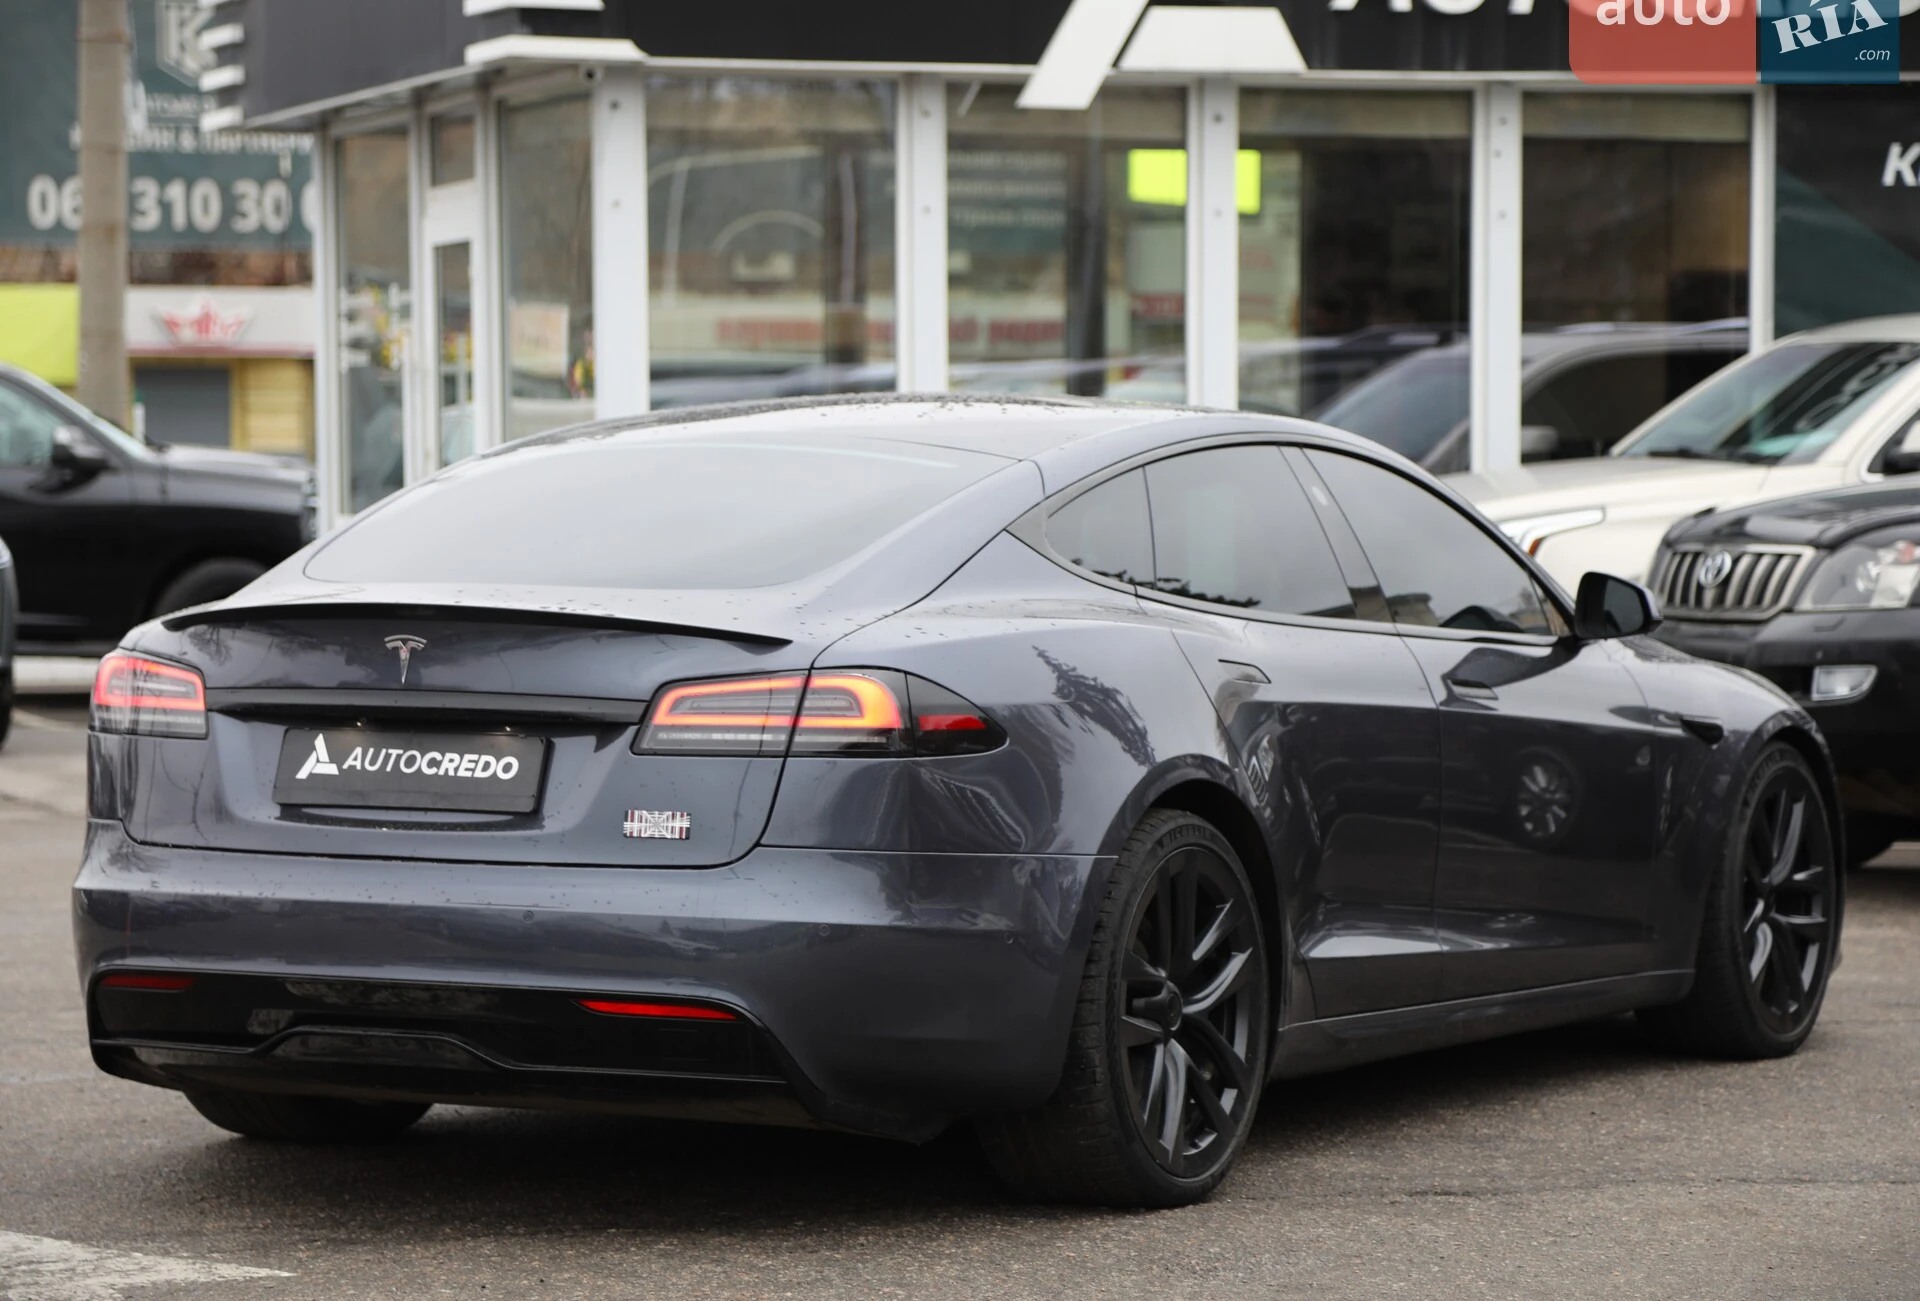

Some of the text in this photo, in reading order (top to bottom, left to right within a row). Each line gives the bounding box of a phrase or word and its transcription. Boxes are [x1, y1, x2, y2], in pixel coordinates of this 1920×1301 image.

[27, 174, 83, 231] 06
[131, 176, 222, 233] 310
[230, 178, 292, 234] 30
[342, 746, 519, 780] AUTOCREDO
